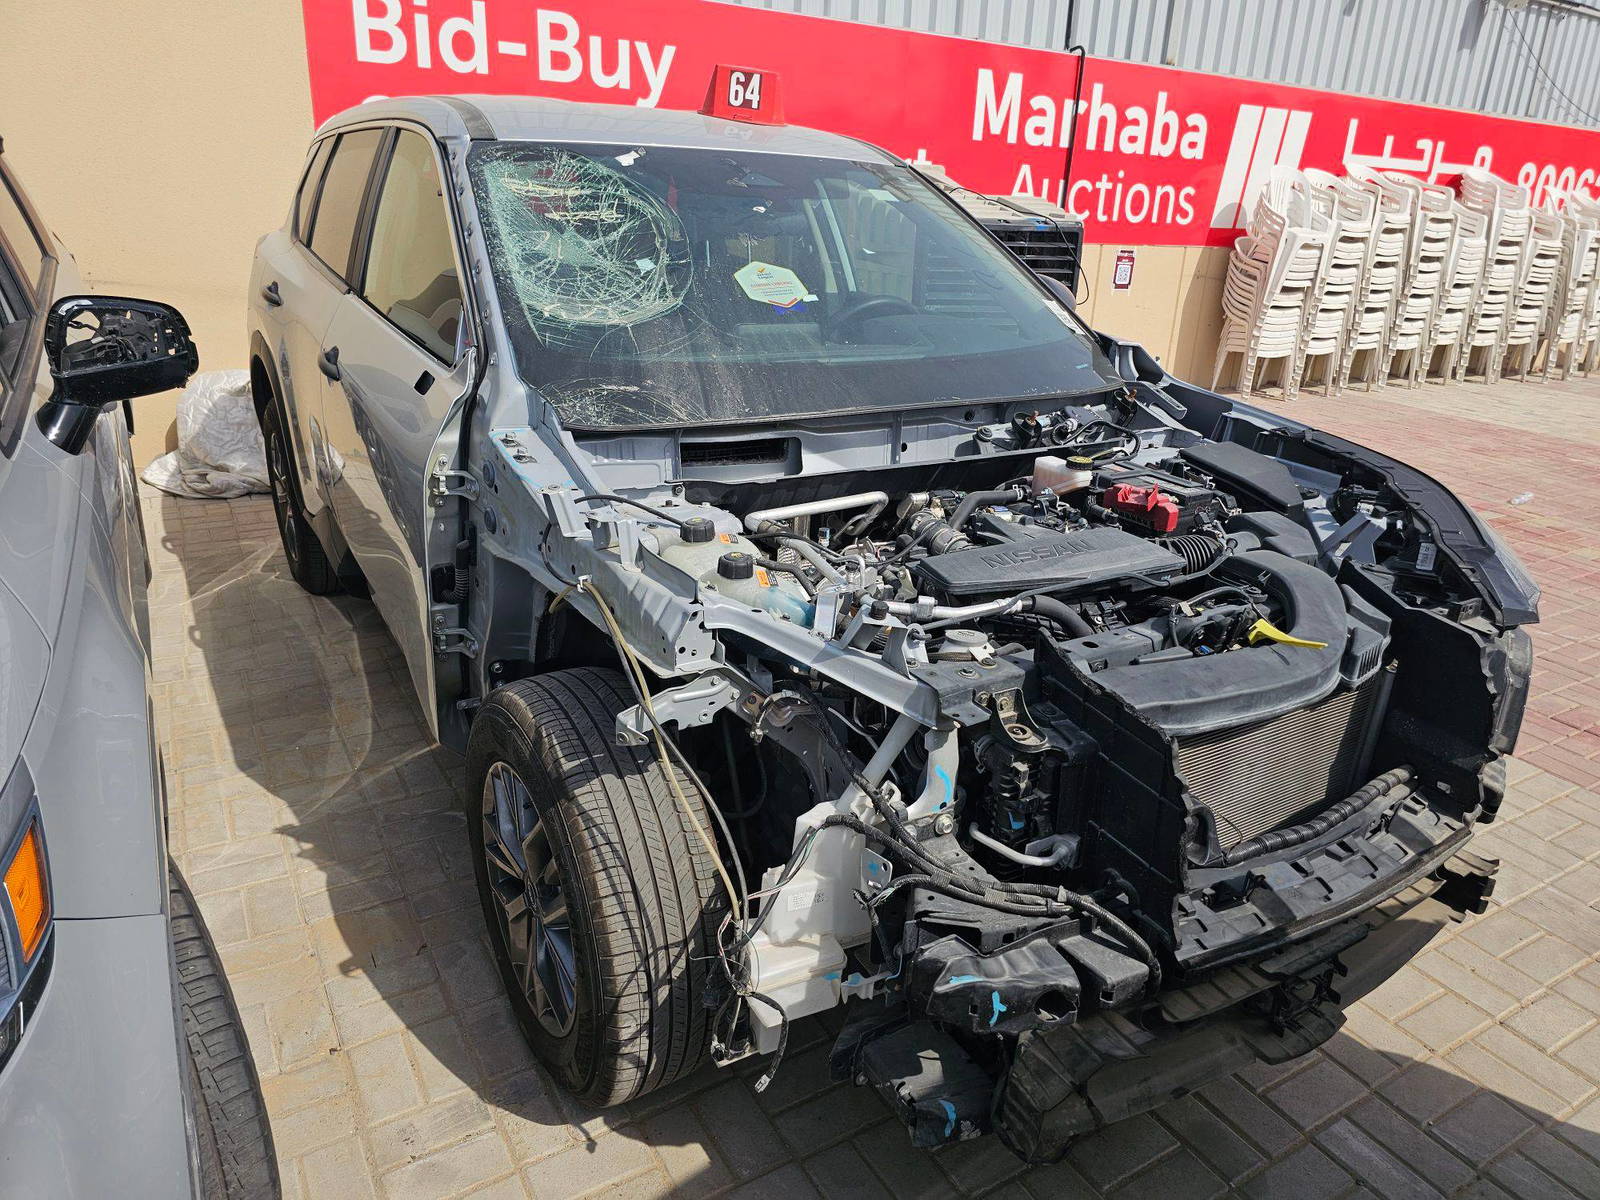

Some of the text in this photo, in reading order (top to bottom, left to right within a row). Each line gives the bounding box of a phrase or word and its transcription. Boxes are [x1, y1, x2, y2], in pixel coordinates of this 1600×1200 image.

[352, 0, 677, 108] Bid-Buy
[729, 71, 761, 109] 64
[972, 68, 1209, 160] Marhaba
[979, 539, 1098, 570] NISSAN
